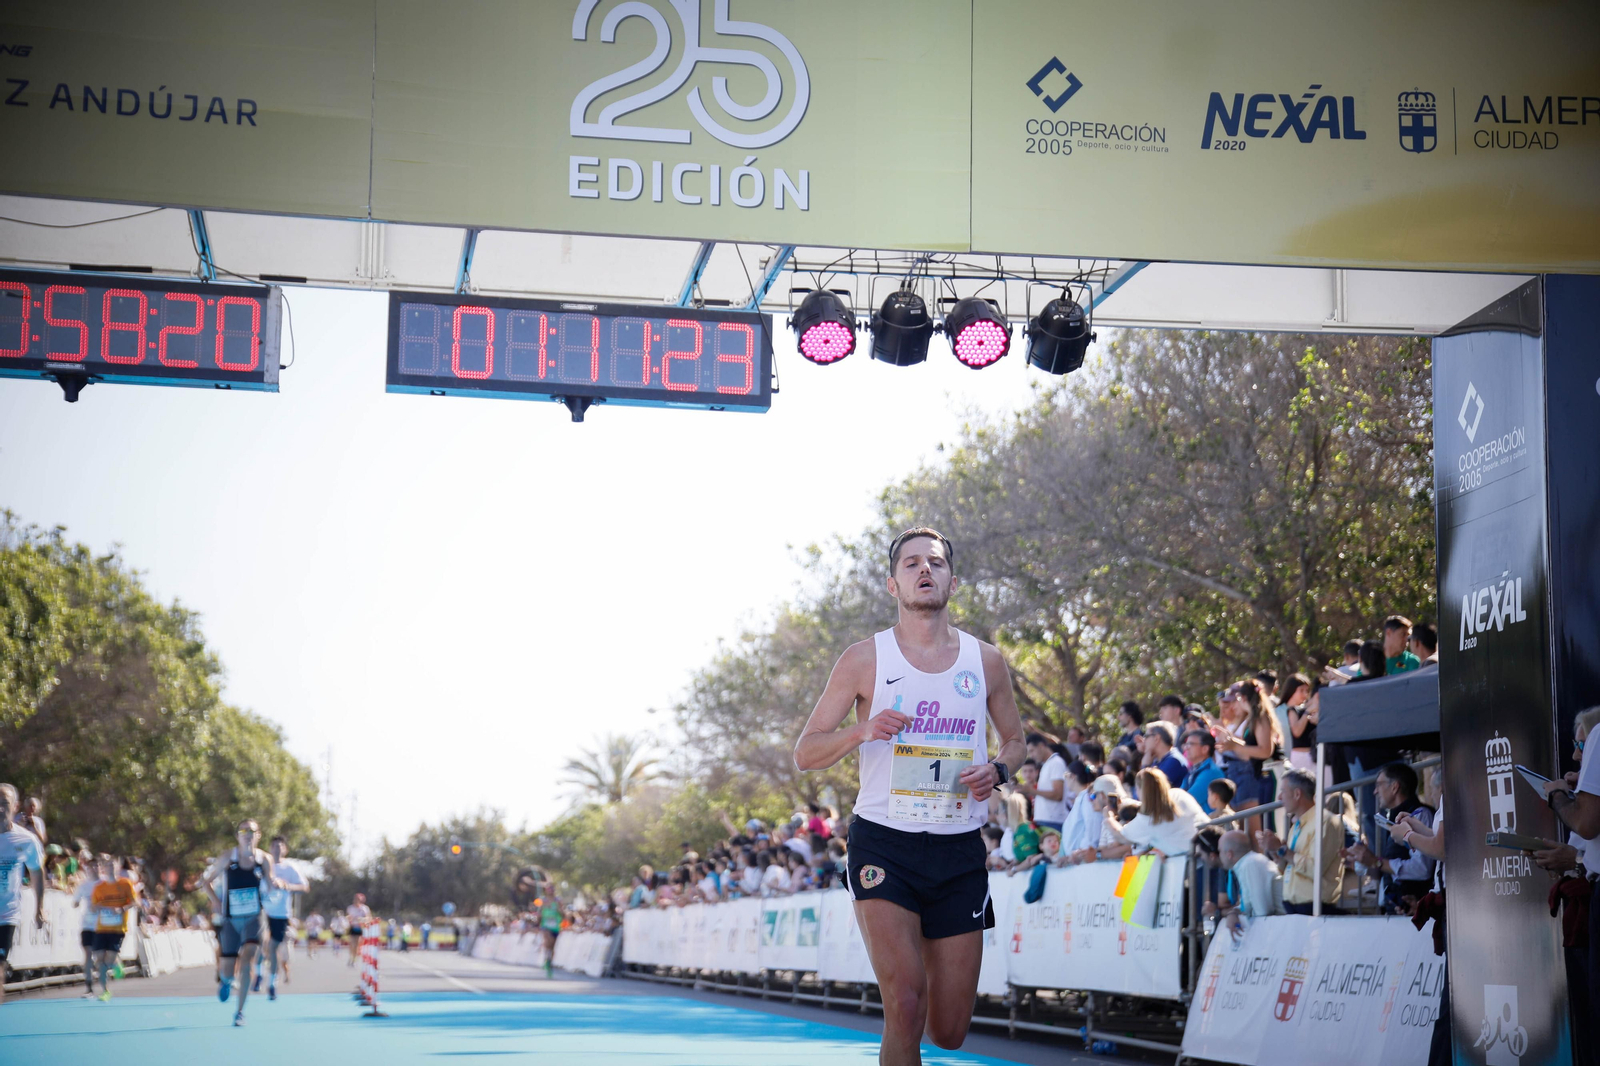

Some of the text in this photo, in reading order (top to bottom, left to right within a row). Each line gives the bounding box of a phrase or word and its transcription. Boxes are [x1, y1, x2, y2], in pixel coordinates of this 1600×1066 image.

[5, 78, 258, 127] Z ANDÚJAR
[1201, 86, 1367, 149] NEXAL
[1025, 118, 1166, 143] COOPERACIÓN
[1473, 130, 1559, 150] CIUDAD
[1025, 137, 1073, 156] 2005
[1077, 139, 1170, 153] Deporte, ocio y cultura
[1214, 139, 1247, 151] 2020
[568, 155, 809, 211] EDICIÓN
[452, 305, 754, 396] 01:11:23
[1458, 426, 1525, 473] COOPERACIÓN
[1459, 467, 1483, 494] 2005
[1459, 571, 1527, 651] NEXAL
[1464, 636, 1478, 650] 2020
[916, 700, 940, 718] GQ
[929, 759, 941, 782] 1
[917, 782, 950, 790] ALBERTO
[1482, 850, 1532, 879] ALMERÍA
[1495, 881, 1521, 895] CIUDAD
[1316, 955, 1388, 998] ALMERÍA
[1309, 1001, 1346, 1022] CIUDAD
